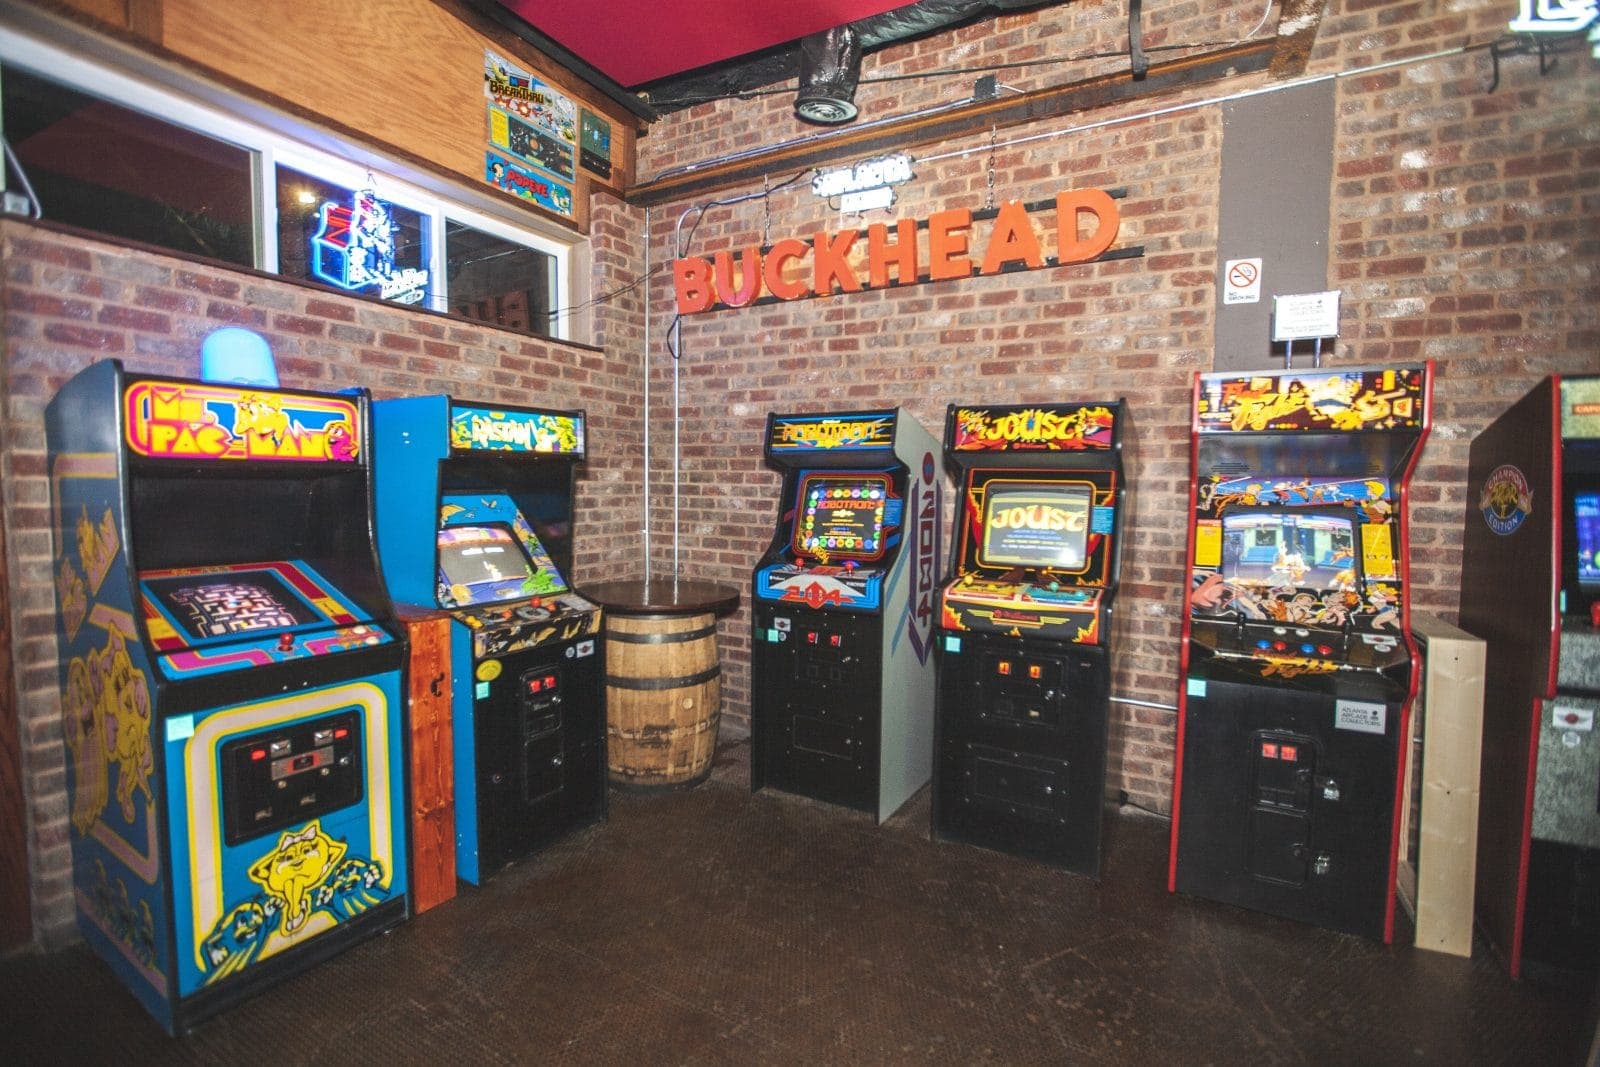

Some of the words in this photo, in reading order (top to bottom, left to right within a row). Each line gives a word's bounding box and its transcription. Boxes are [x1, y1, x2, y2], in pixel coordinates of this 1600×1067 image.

[673, 187, 1120, 315] BUCKHEAD
[783, 421, 876, 441] ROBOTRON
[986, 408, 1079, 441] JOUST
[1488, 469, 1523, 490] CHAMPION
[991, 504, 1087, 532] JOUST
[1488, 515, 1518, 531] EDITION
[1341, 711, 1368, 720] ARCADE
[1342, 706, 1368, 715] ATLANTA
[1340, 717, 1381, 727] COLLECTORS
